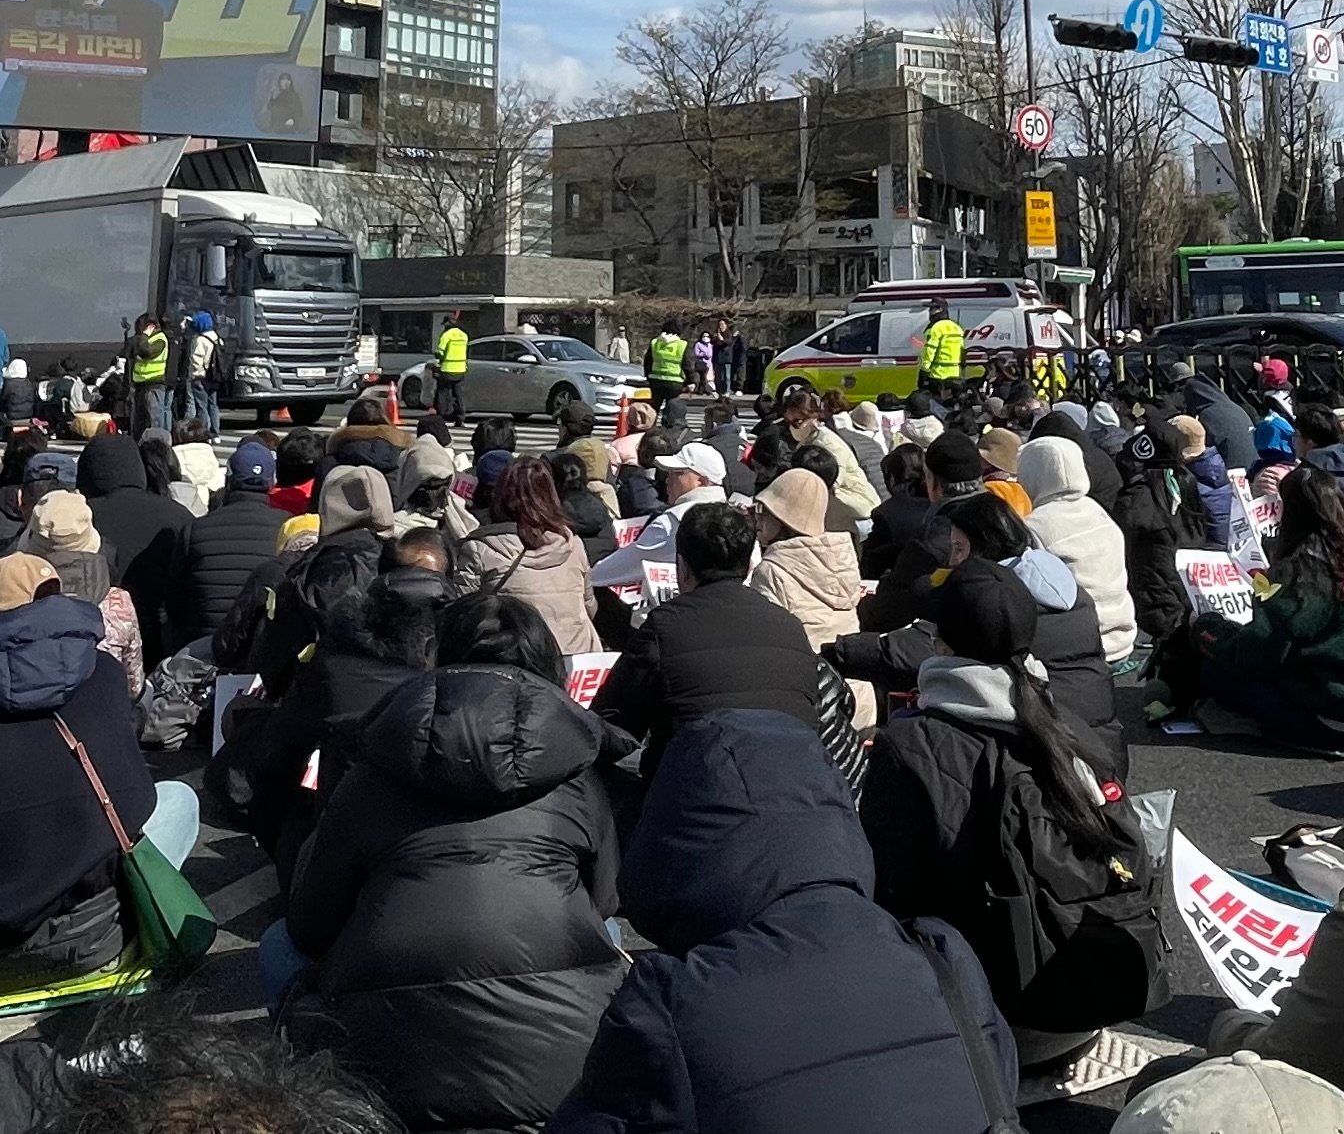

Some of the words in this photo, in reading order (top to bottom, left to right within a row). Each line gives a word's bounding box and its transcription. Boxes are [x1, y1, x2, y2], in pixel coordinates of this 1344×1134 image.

[9, 28, 69, 54] 즉각
[77, 34, 142, 60] 파면!
[1024, 118, 1045, 136] 50
